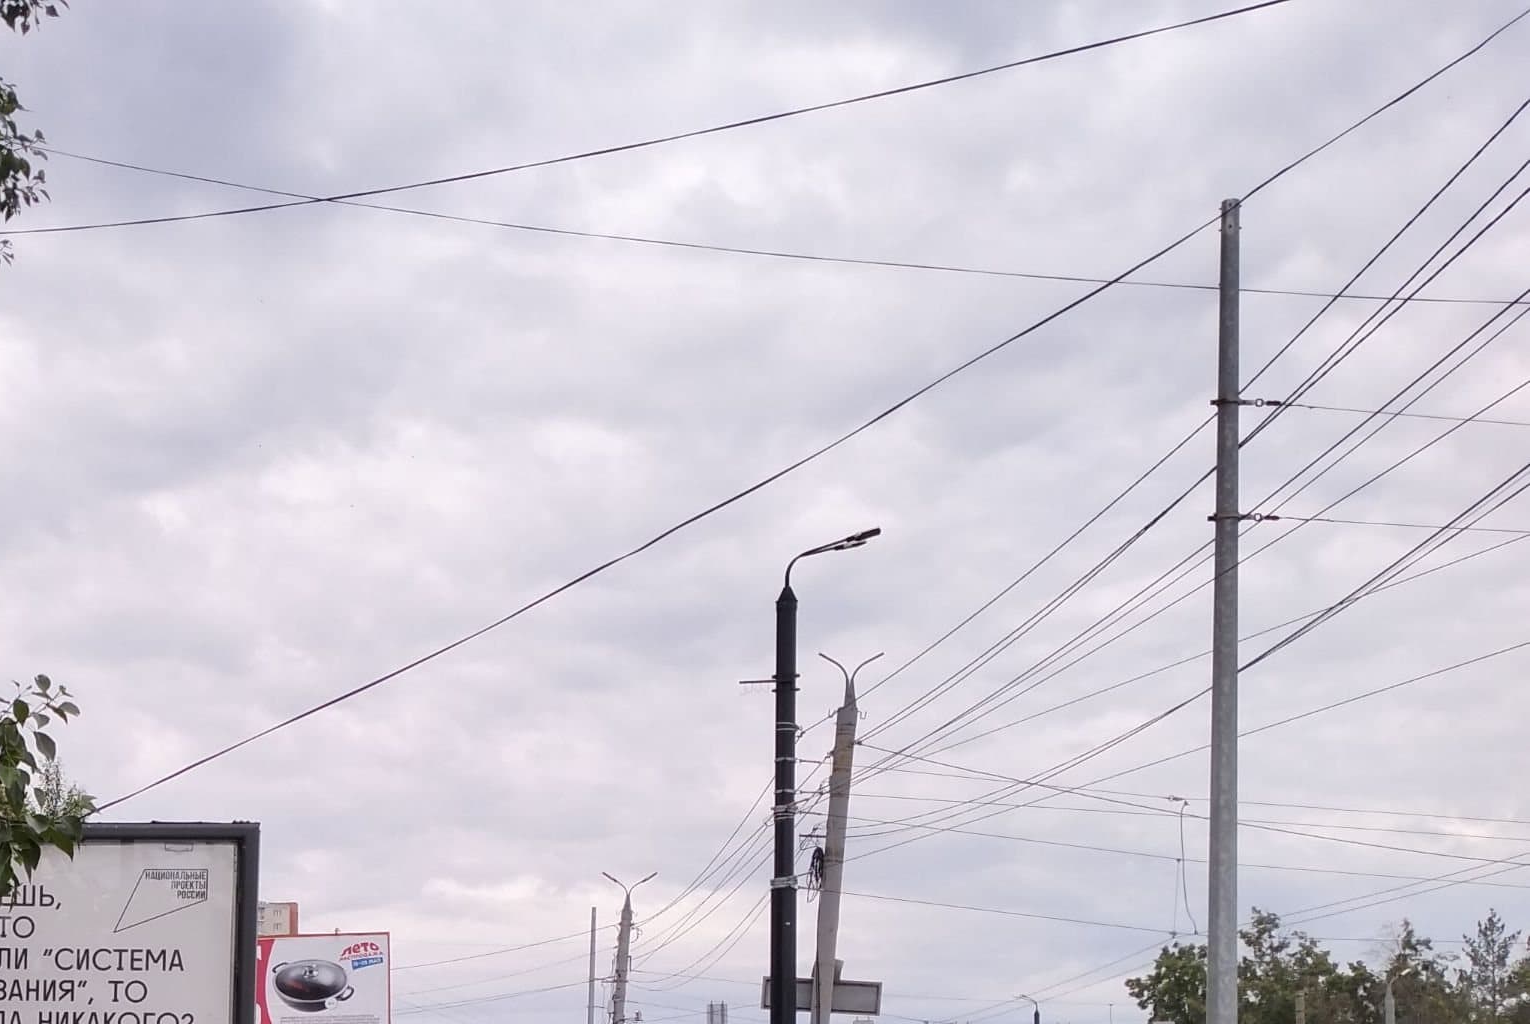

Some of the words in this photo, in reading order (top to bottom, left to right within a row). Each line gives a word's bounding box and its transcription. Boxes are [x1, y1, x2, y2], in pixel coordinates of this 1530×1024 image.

[145, 871, 206, 881] НАЦИОНАЛЬНЫЕ
[171, 881, 206, 890] ПРОЕКТЫ
[176, 890, 206, 899] РОССИИ
[43, 948, 185, 972] "СИСТЕМА
[108, 980, 148, 1003] ТО
